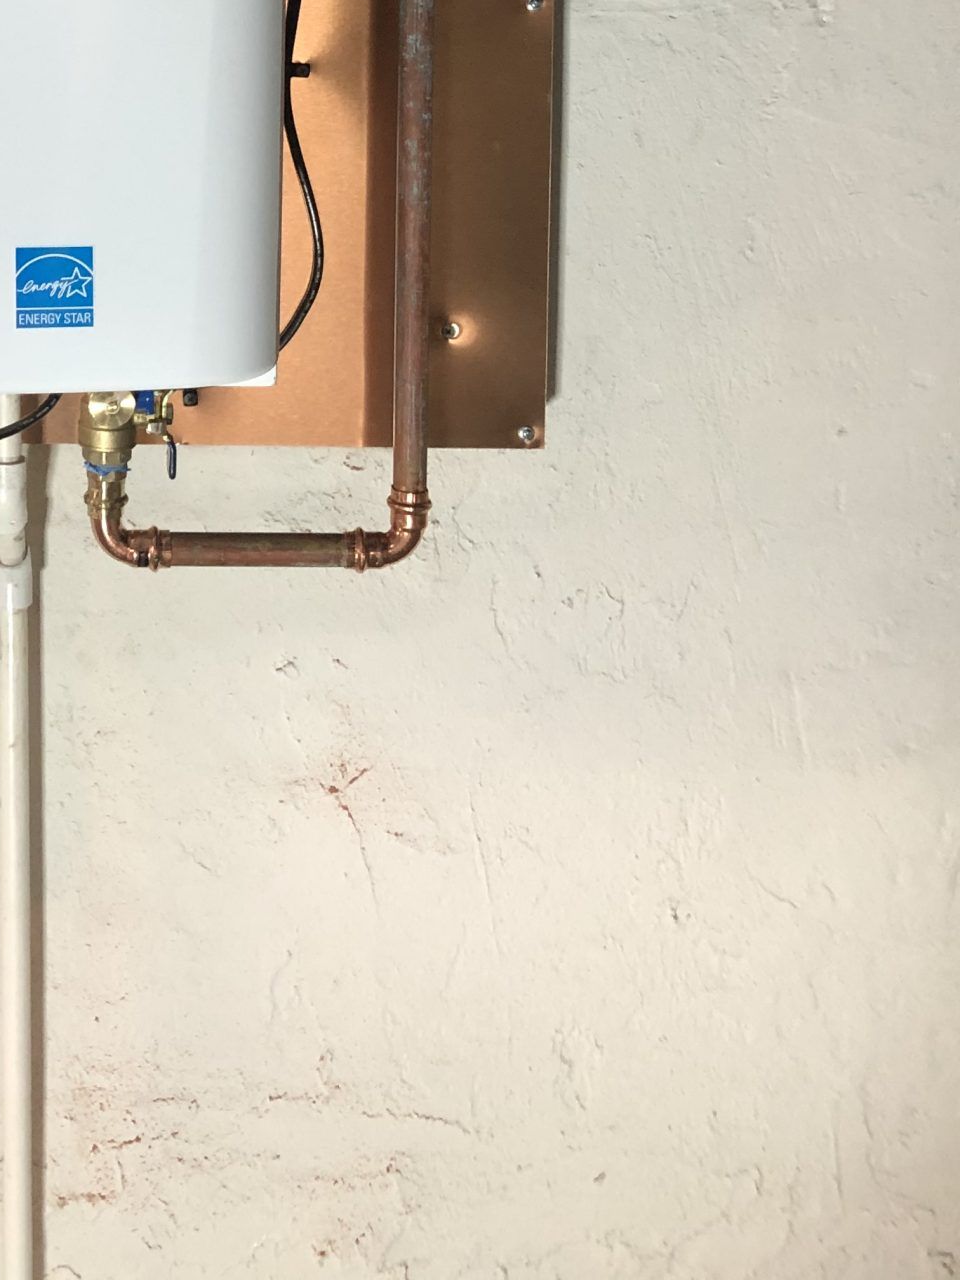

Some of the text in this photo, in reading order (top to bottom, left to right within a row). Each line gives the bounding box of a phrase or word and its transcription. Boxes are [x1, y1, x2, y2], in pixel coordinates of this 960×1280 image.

[20, 279, 70, 299] energy
[18, 312, 92, 325] ENERGY STAR
